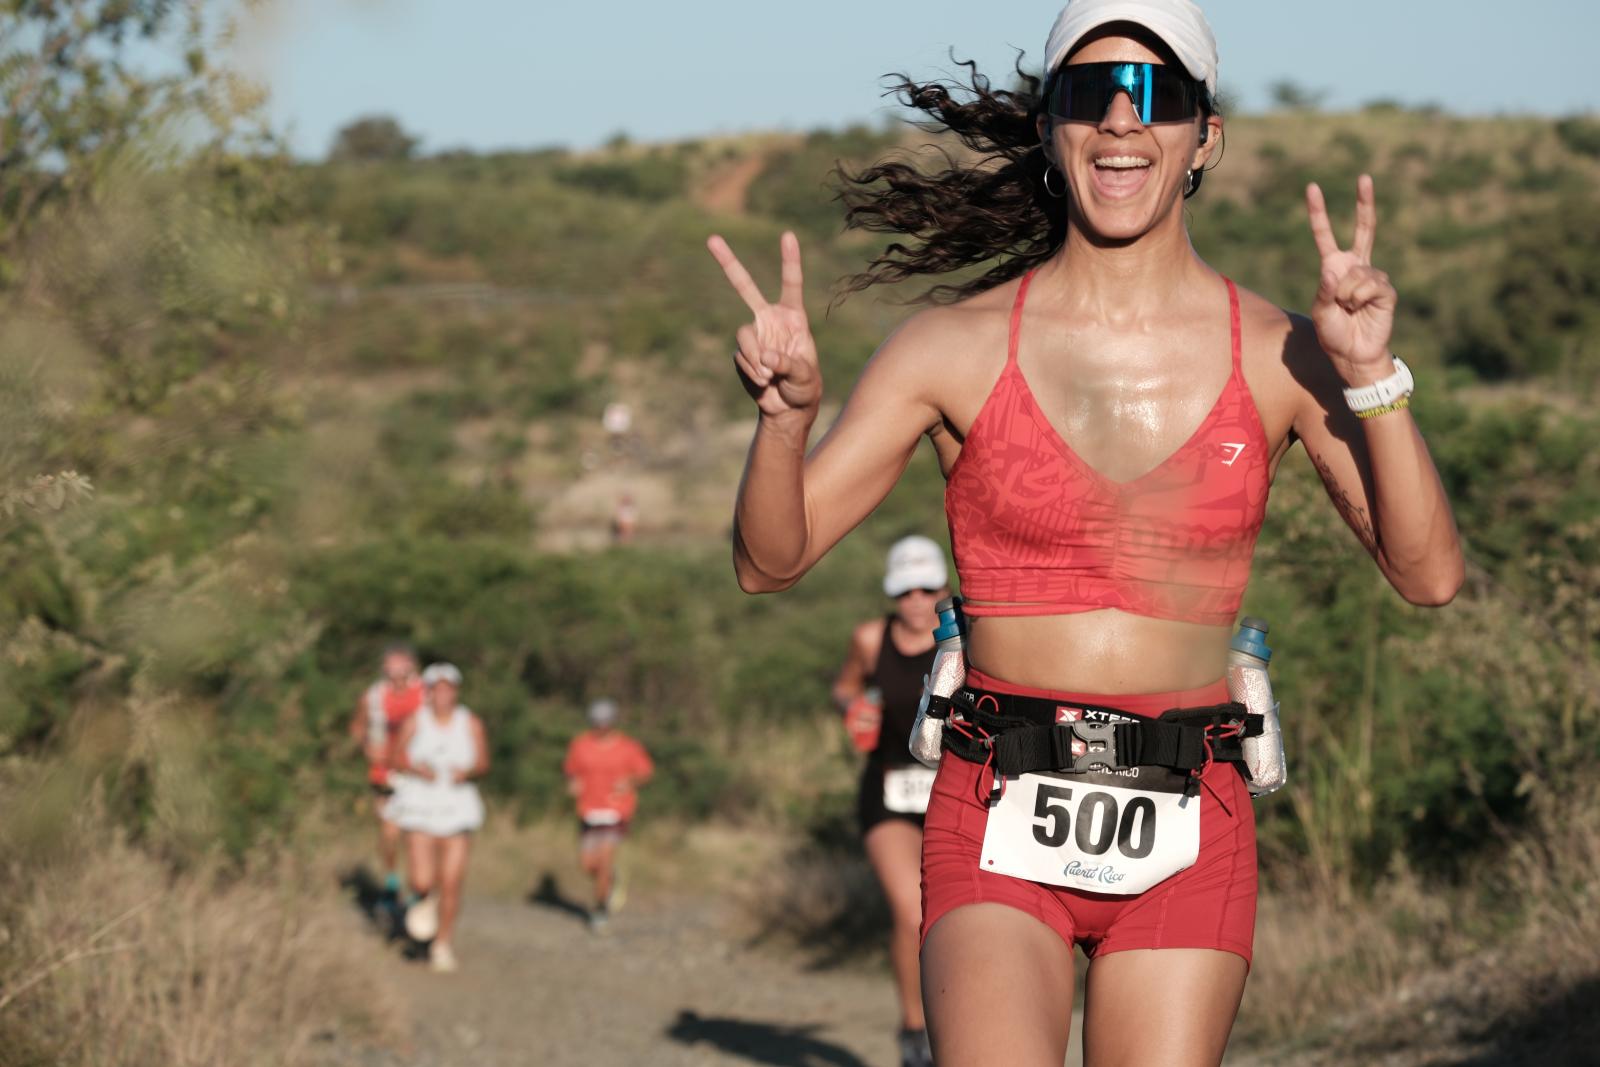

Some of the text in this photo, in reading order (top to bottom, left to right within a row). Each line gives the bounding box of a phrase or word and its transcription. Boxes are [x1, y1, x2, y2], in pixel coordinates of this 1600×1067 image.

[1032, 783, 1156, 859] 500
[1063, 860, 1126, 884] Puerto Rico
